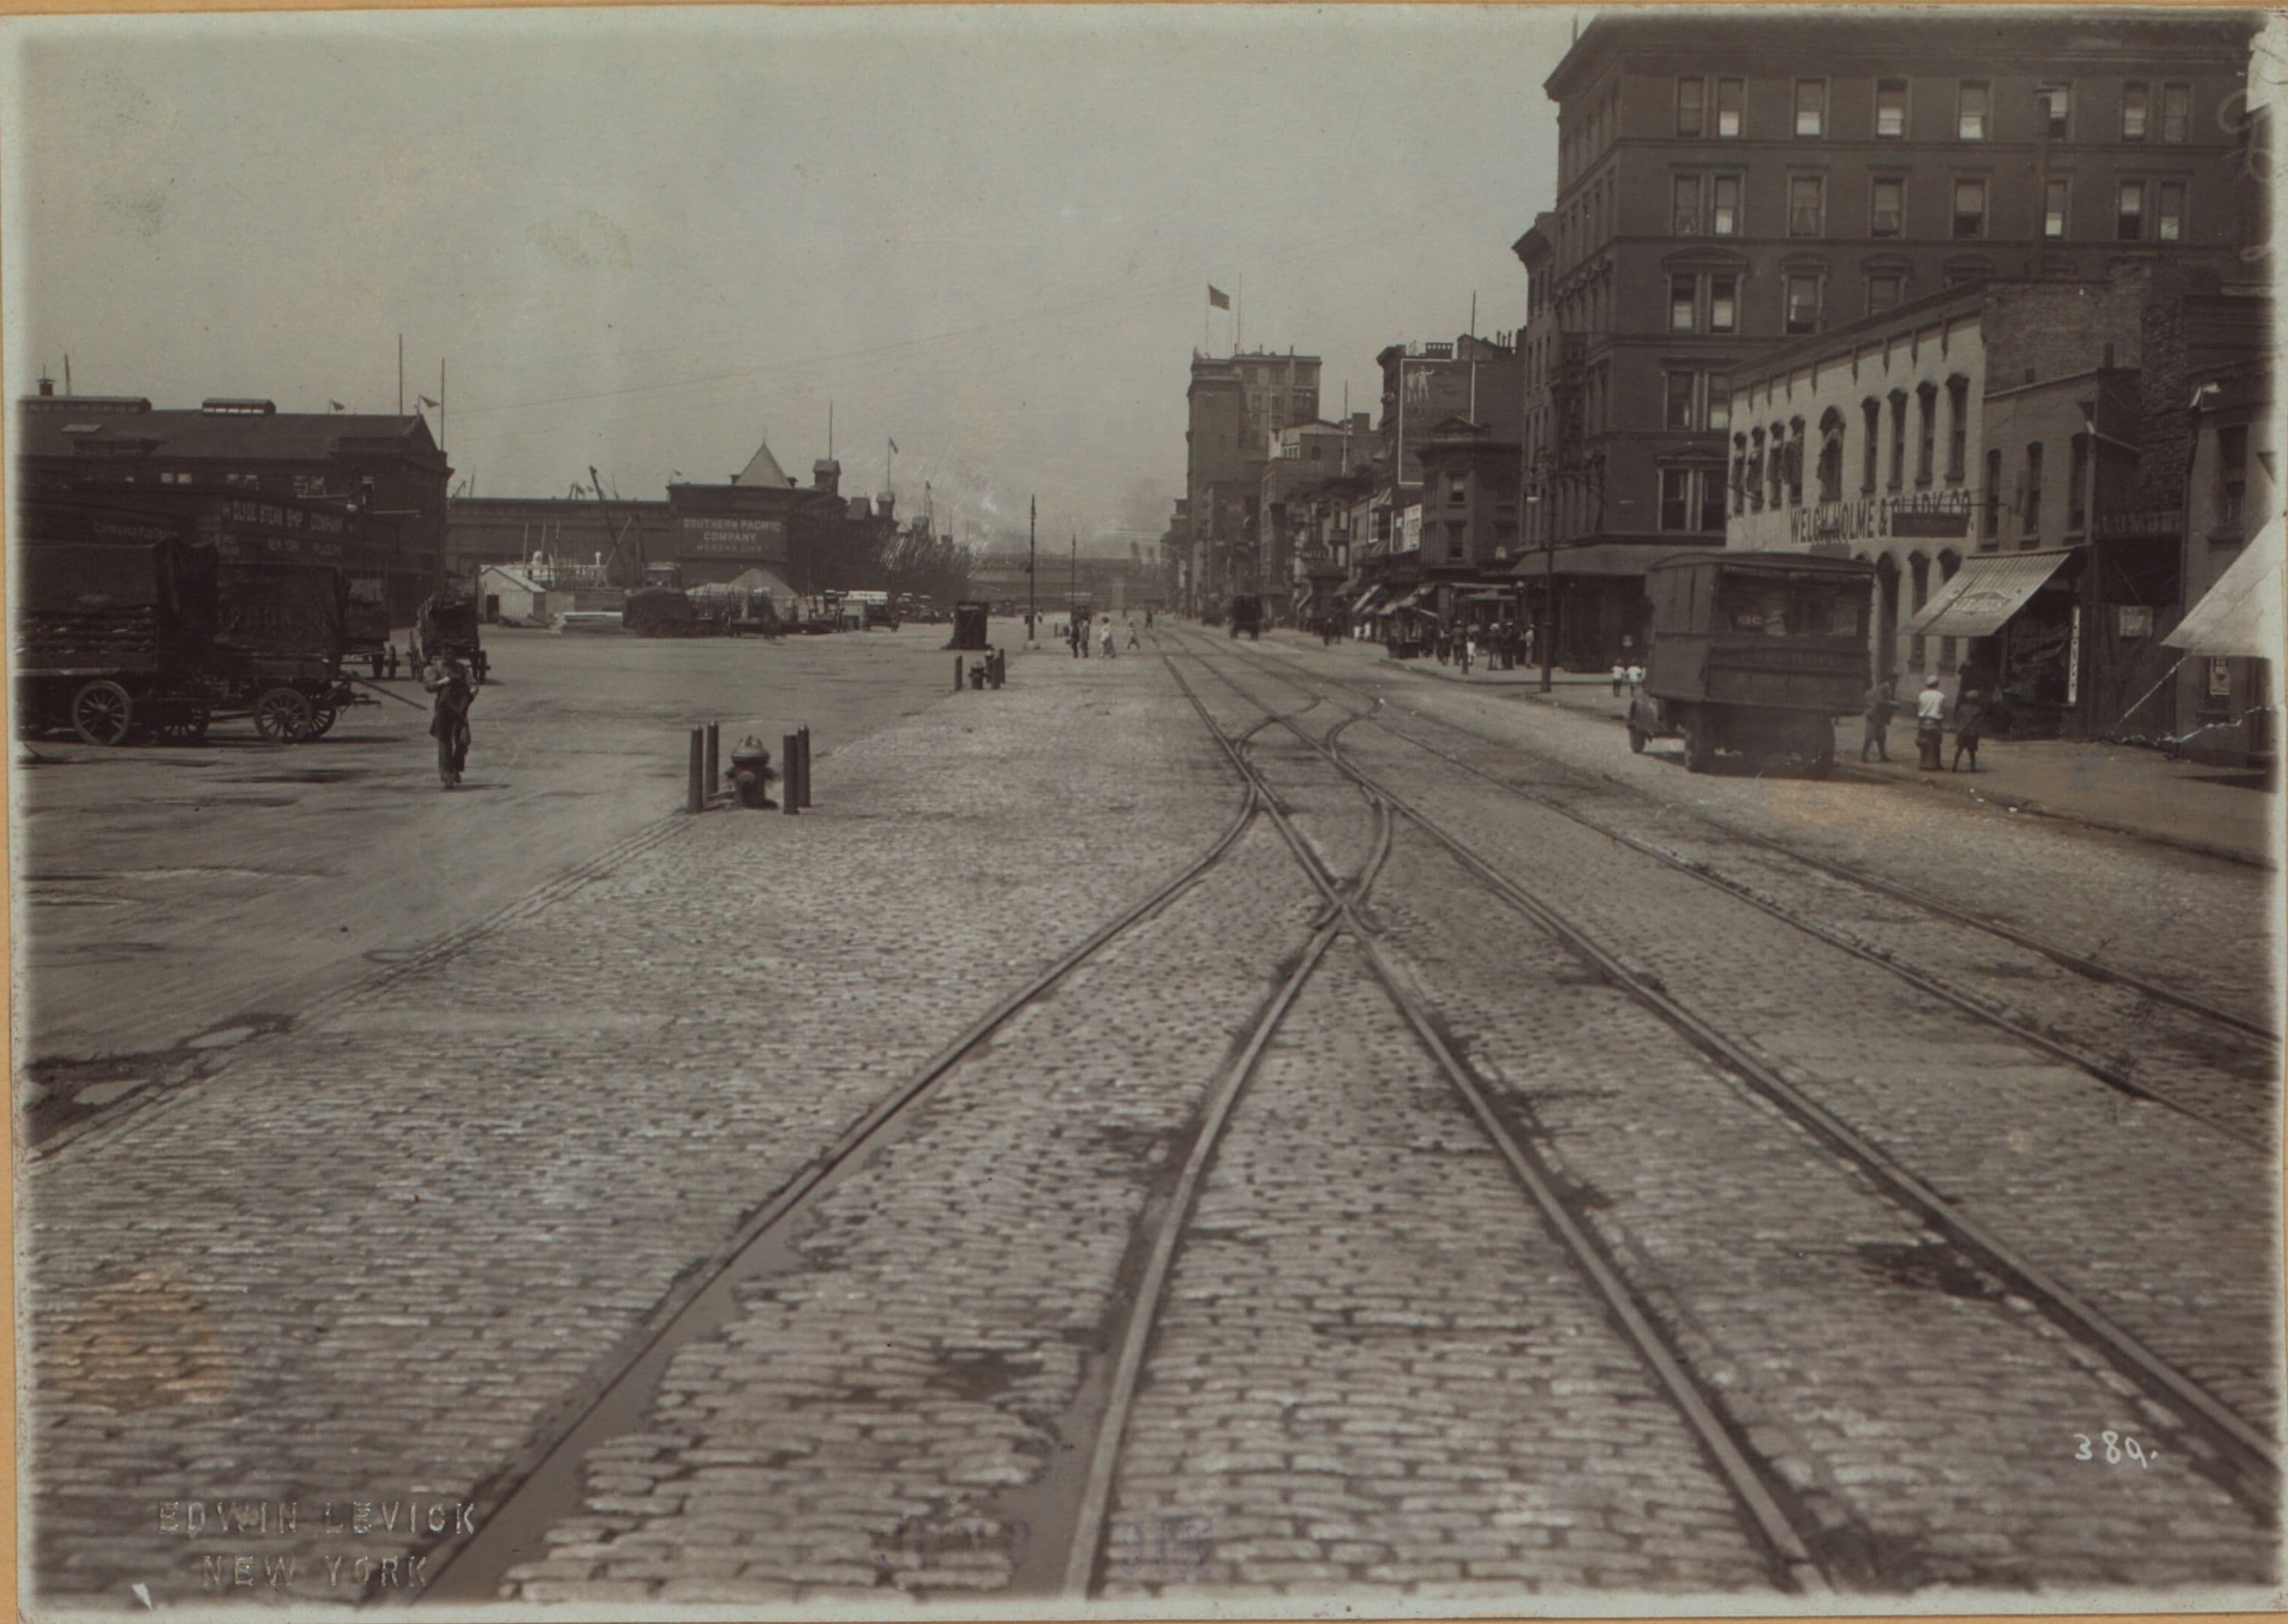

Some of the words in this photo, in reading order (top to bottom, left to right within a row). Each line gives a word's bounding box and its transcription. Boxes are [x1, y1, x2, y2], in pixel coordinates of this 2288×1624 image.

[1878, 496, 1888, 537] &
[683, 518, 739, 531] SOUTHERN
[704, 531, 757, 543] COMPANY
